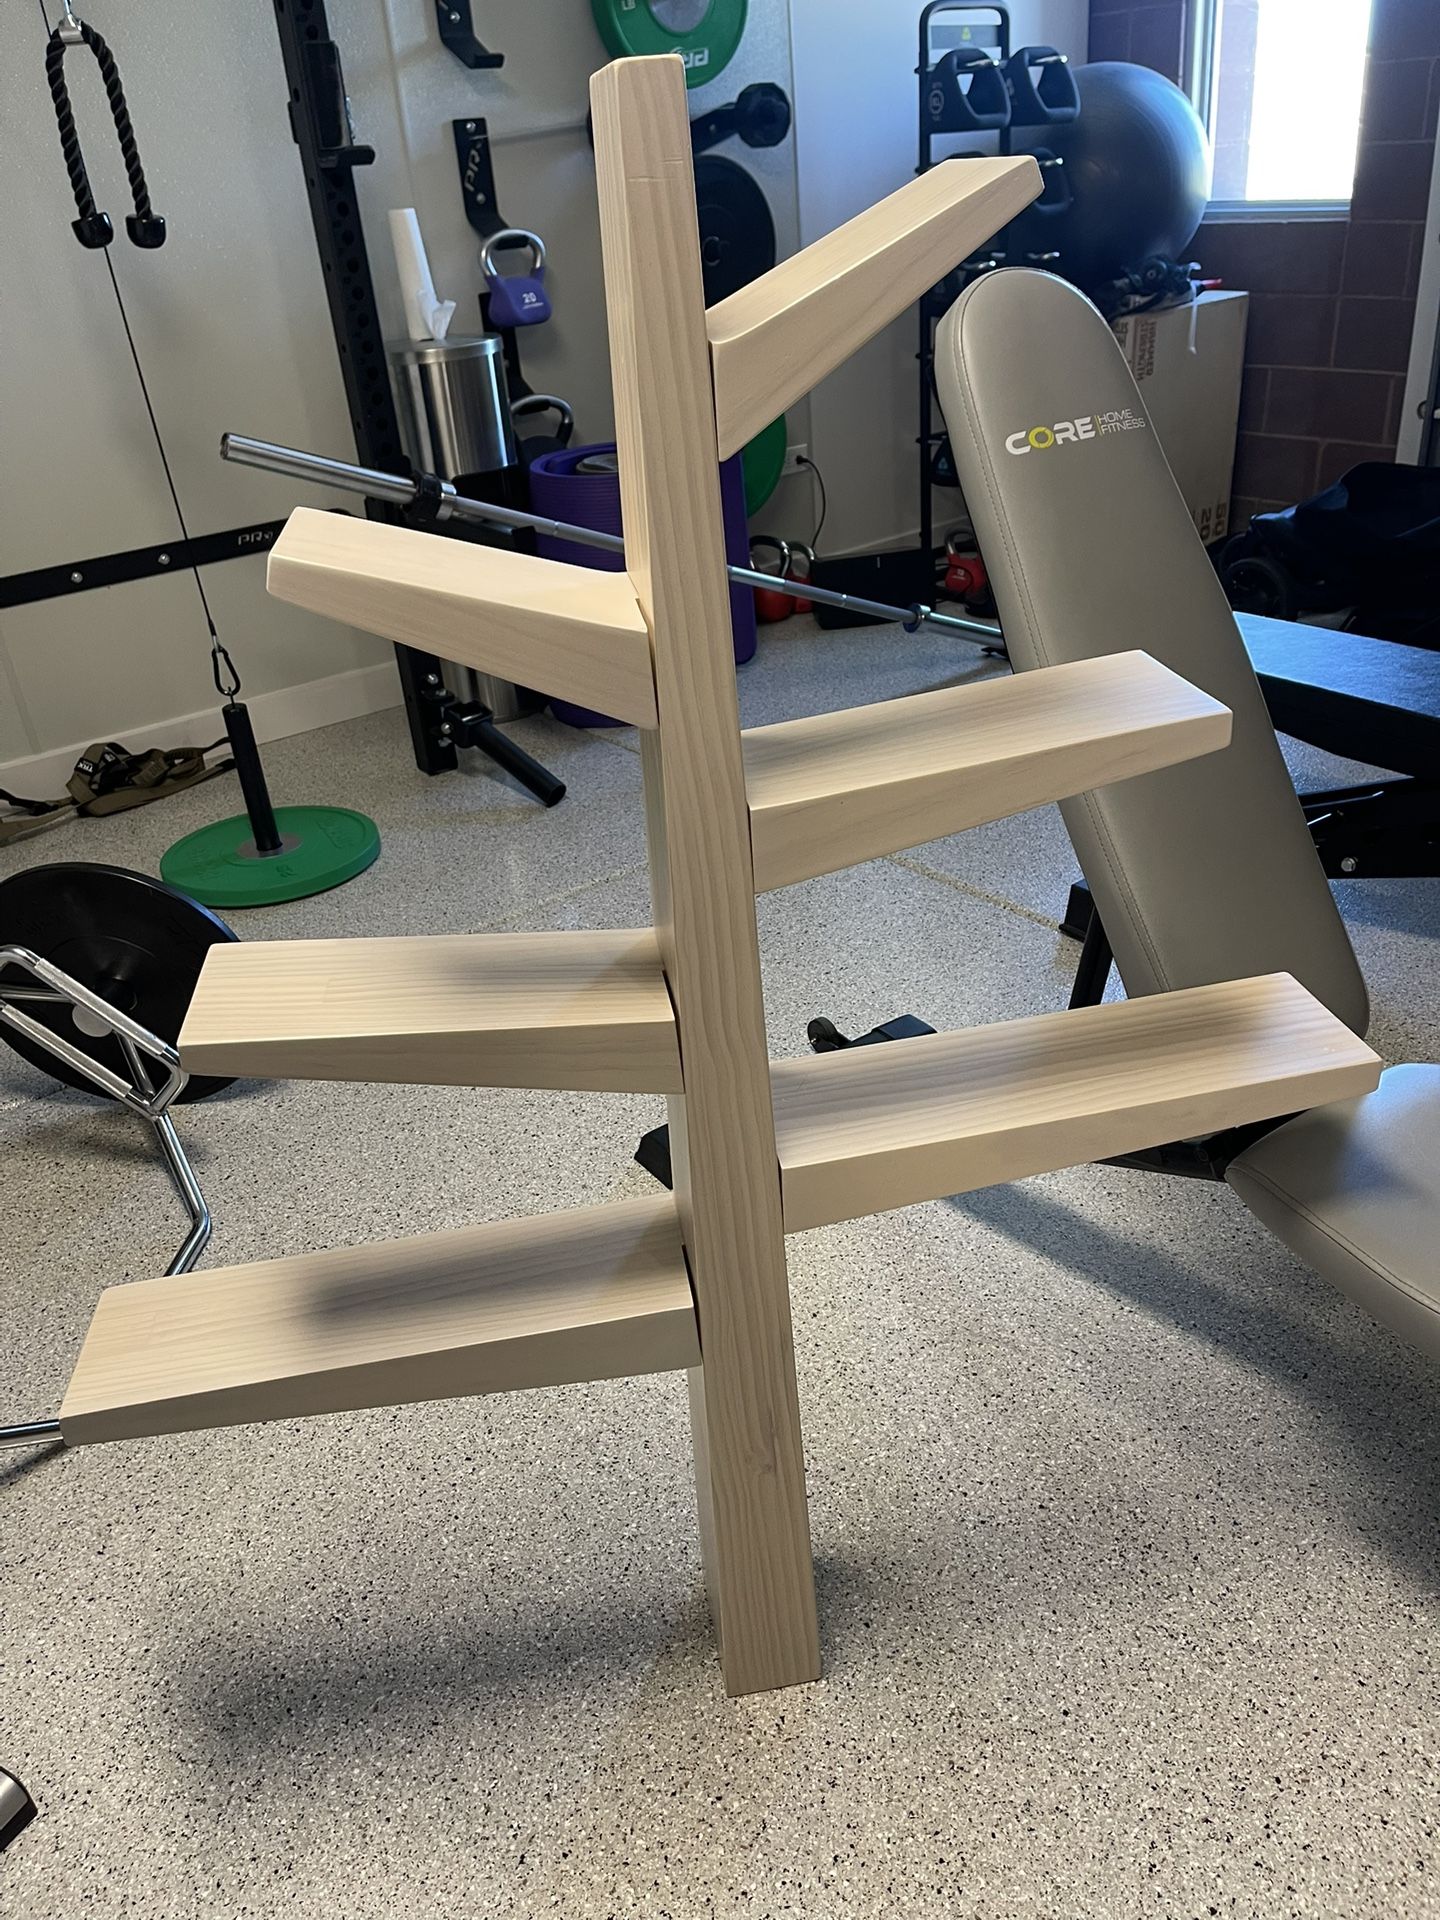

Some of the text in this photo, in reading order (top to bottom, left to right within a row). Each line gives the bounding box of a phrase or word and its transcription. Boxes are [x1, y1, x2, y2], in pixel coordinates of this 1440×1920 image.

[522, 292, 537, 303] 20
[1098, 408, 1134, 425] HOME
[1101, 417, 1146, 435] FITNESS
[1005, 416, 1096, 455] CORE
